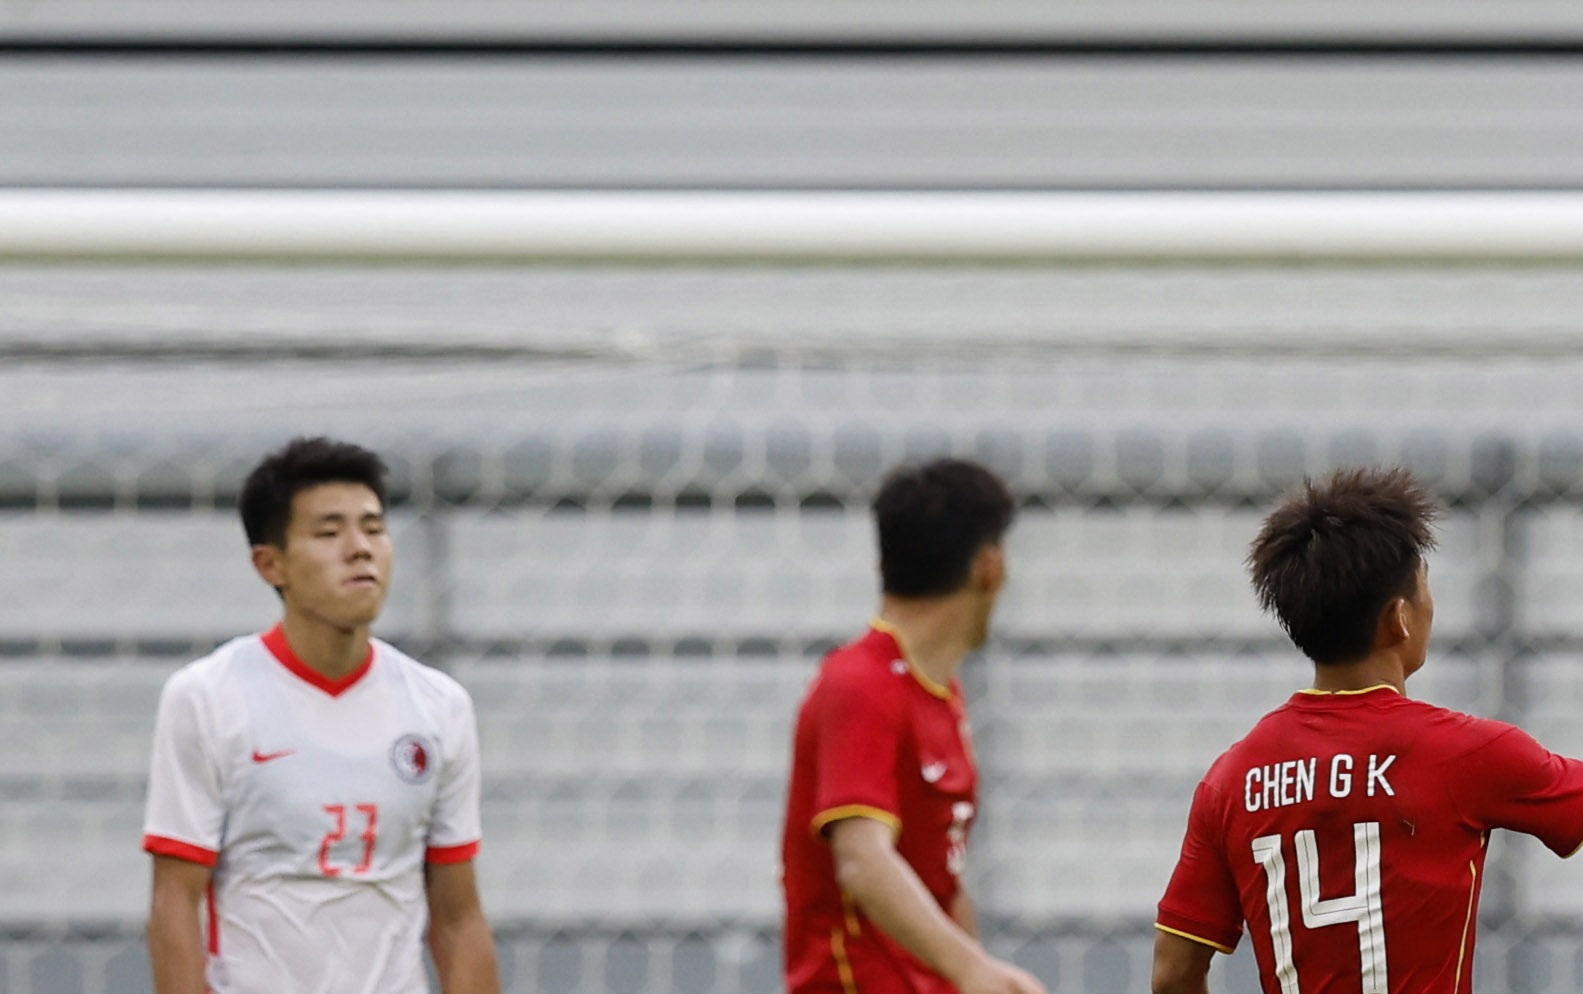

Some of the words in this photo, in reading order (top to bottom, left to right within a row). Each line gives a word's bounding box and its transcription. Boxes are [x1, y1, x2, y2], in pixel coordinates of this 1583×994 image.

[1245, 758, 1317, 812] CHEN
[1329, 754, 1353, 798] G
[1367, 754, 1396, 797] K
[317, 803, 378, 877] 23
